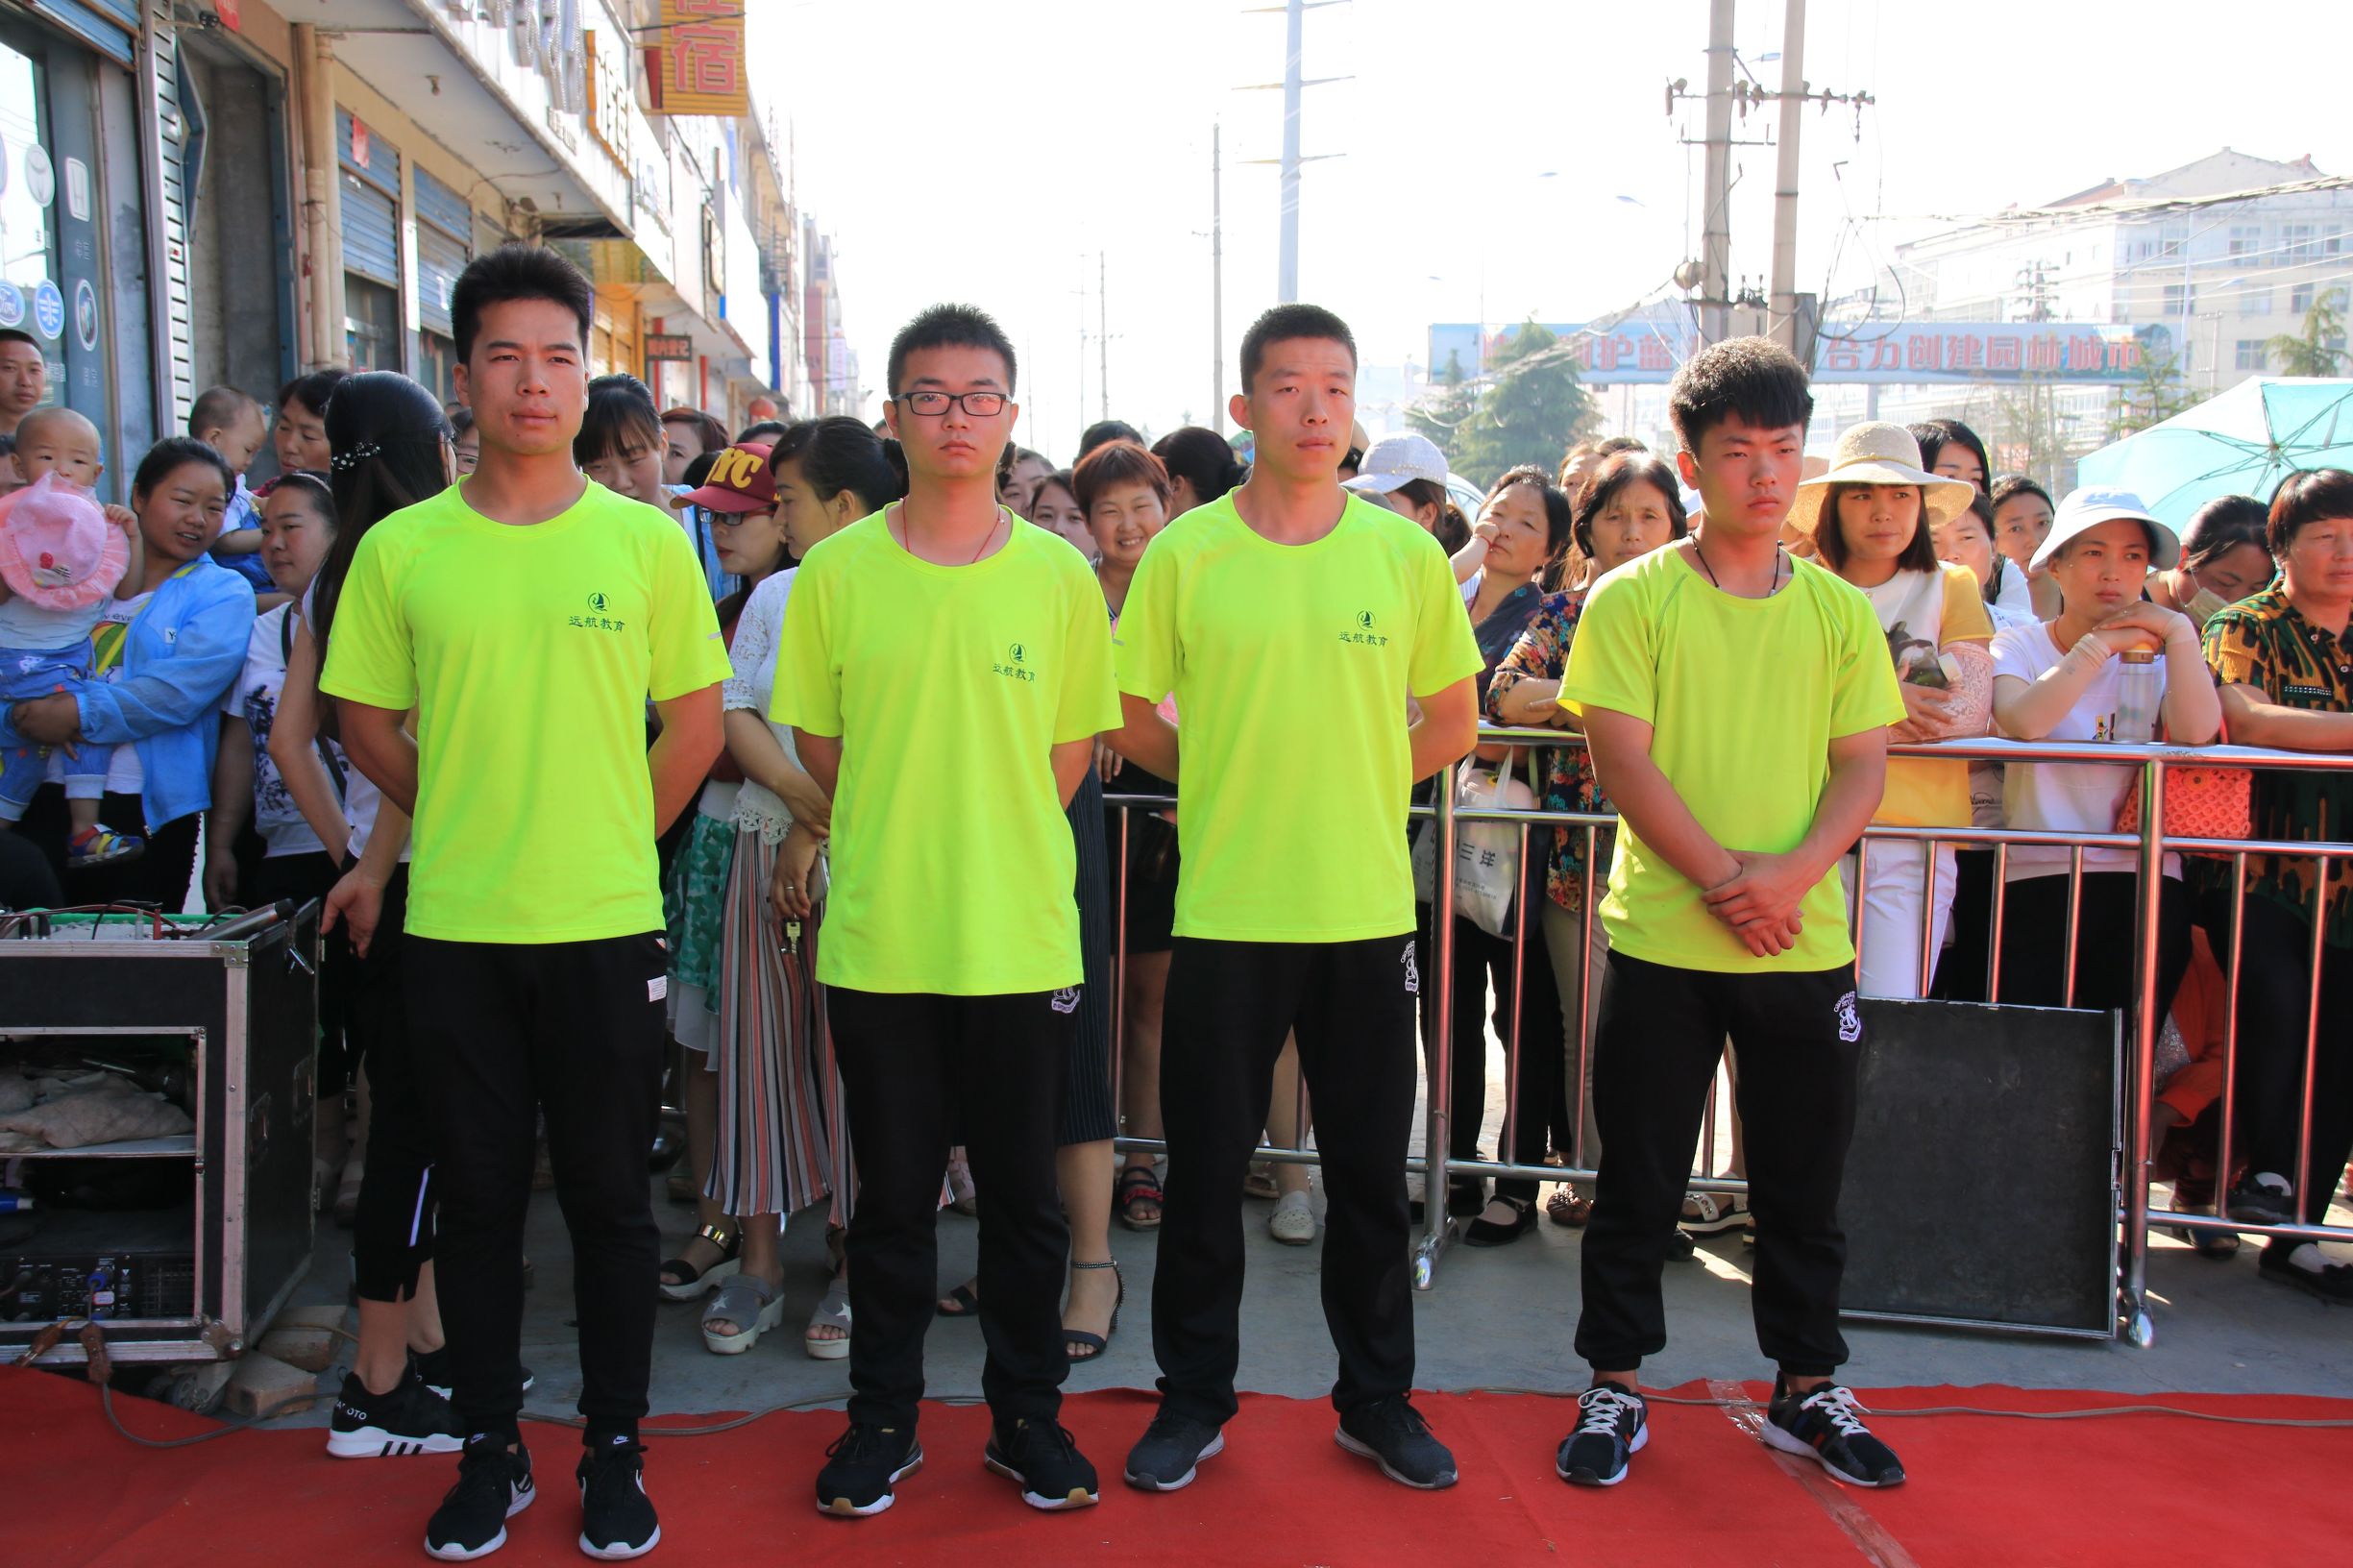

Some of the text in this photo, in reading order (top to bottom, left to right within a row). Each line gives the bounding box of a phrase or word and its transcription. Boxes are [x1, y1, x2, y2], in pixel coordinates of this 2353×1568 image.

[671, 0, 738, 94] 宿
[1826, 332, 2142, 371] 合力创建园林城市
[568, 615, 625, 633] 远航教育
[1338, 631, 1388, 648] 远航教育
[1456, 839, 1496, 869] 三洋
